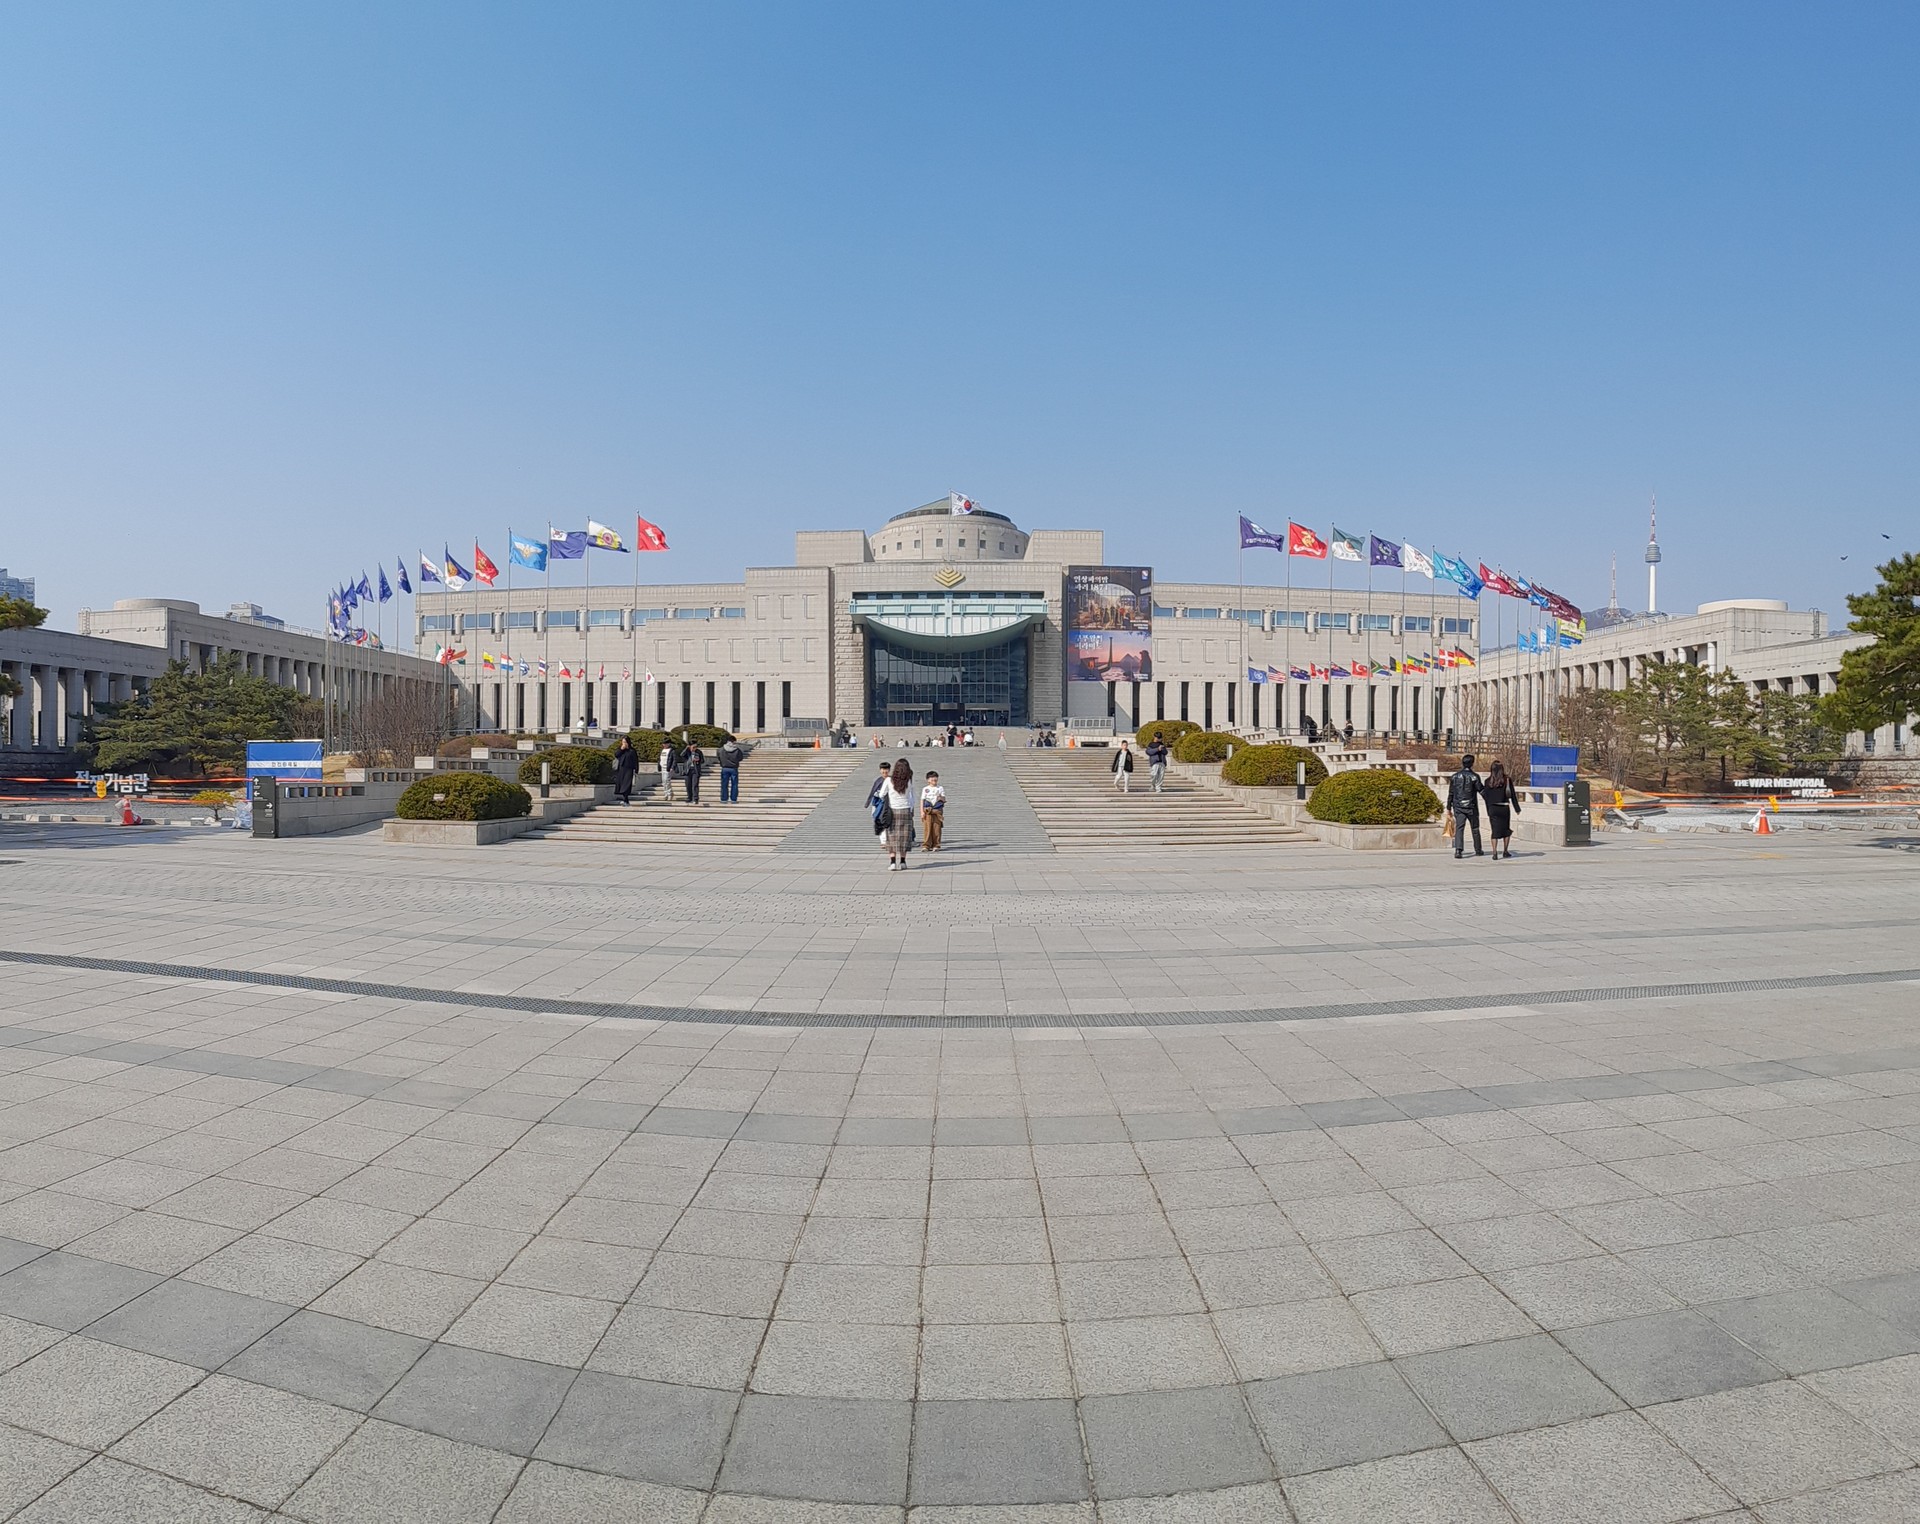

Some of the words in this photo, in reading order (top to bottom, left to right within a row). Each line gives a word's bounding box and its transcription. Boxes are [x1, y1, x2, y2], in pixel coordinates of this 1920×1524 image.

[1749, 778, 1773, 788] WAR
[1774, 778, 1827, 788] MEMORIAL
[1801, 788, 1835, 798] KOREA
